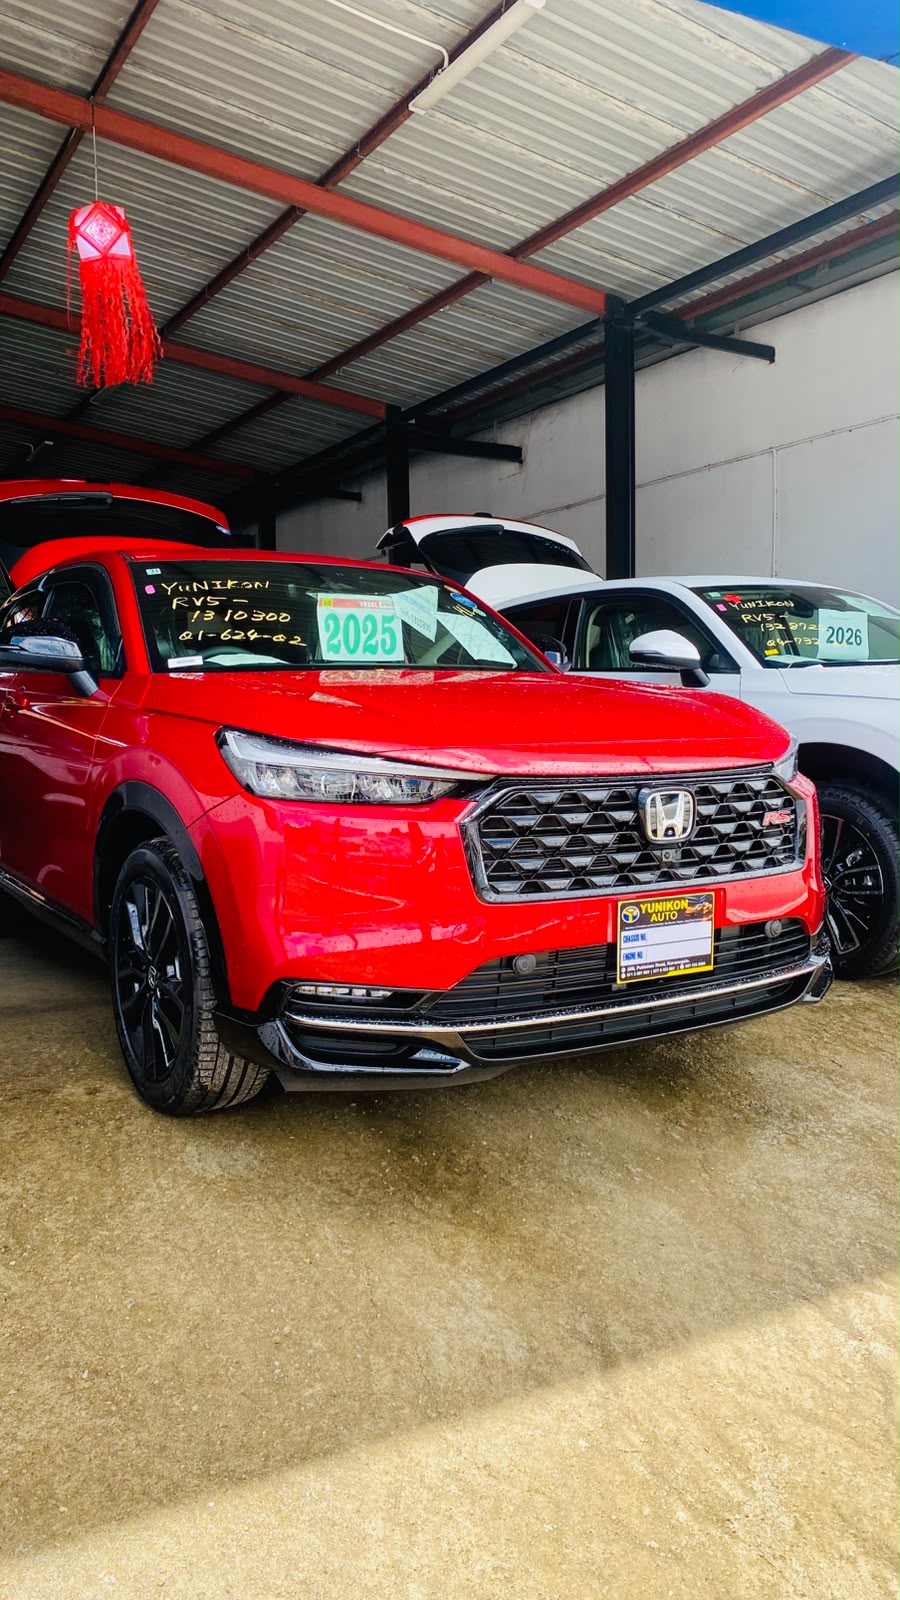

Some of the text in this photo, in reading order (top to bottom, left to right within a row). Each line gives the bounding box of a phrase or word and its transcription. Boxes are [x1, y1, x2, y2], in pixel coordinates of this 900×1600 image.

[324, 613, 397, 655] 2025
[825, 626, 863, 646] 2026
[762, 810, 791, 826] RS
[640, 899, 689, 914] YUNIKON
[650, 911, 679, 923] AUTO
[623, 933, 640, 943] CHASSIS
